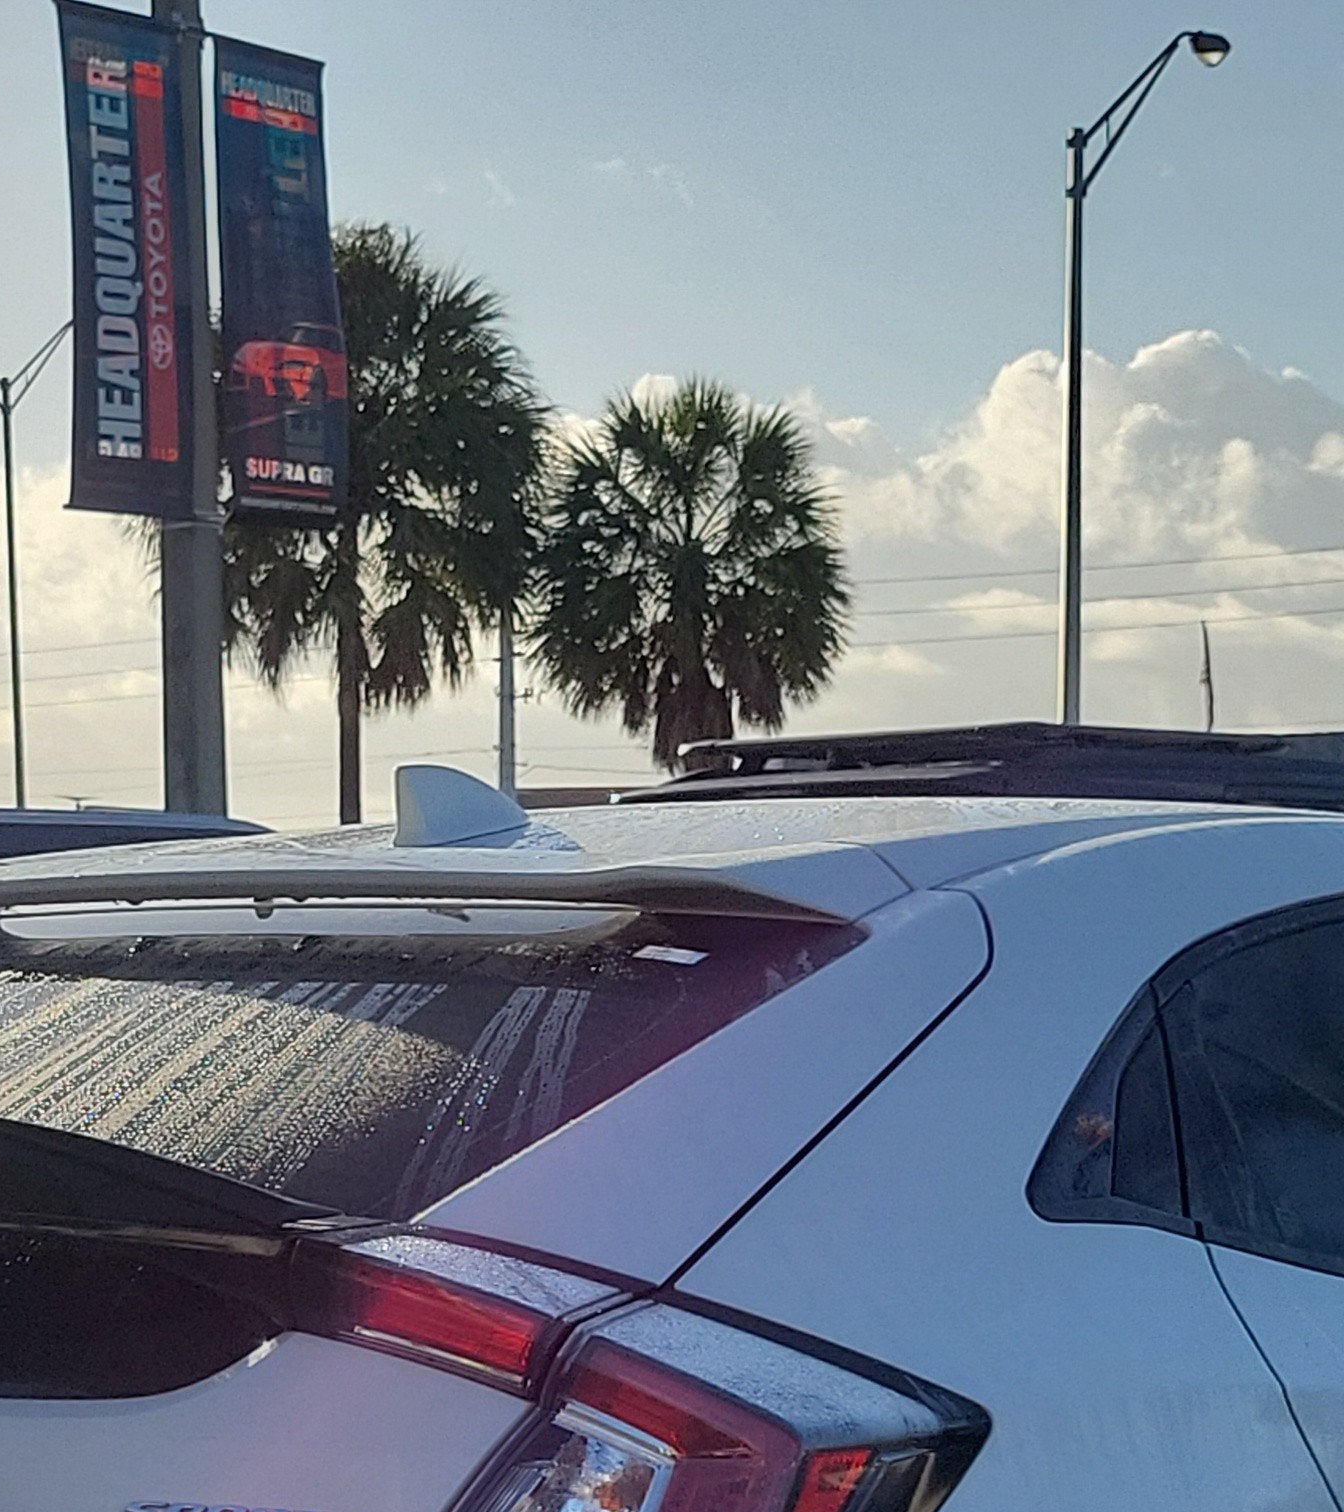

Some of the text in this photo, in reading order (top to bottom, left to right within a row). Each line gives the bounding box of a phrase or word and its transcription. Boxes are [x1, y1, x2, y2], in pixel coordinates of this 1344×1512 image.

[86, 57, 143, 459] HEADQUARTER
[142, 173, 171, 319] TOYOTA
[246, 457, 335, 486] SUPRA GR
